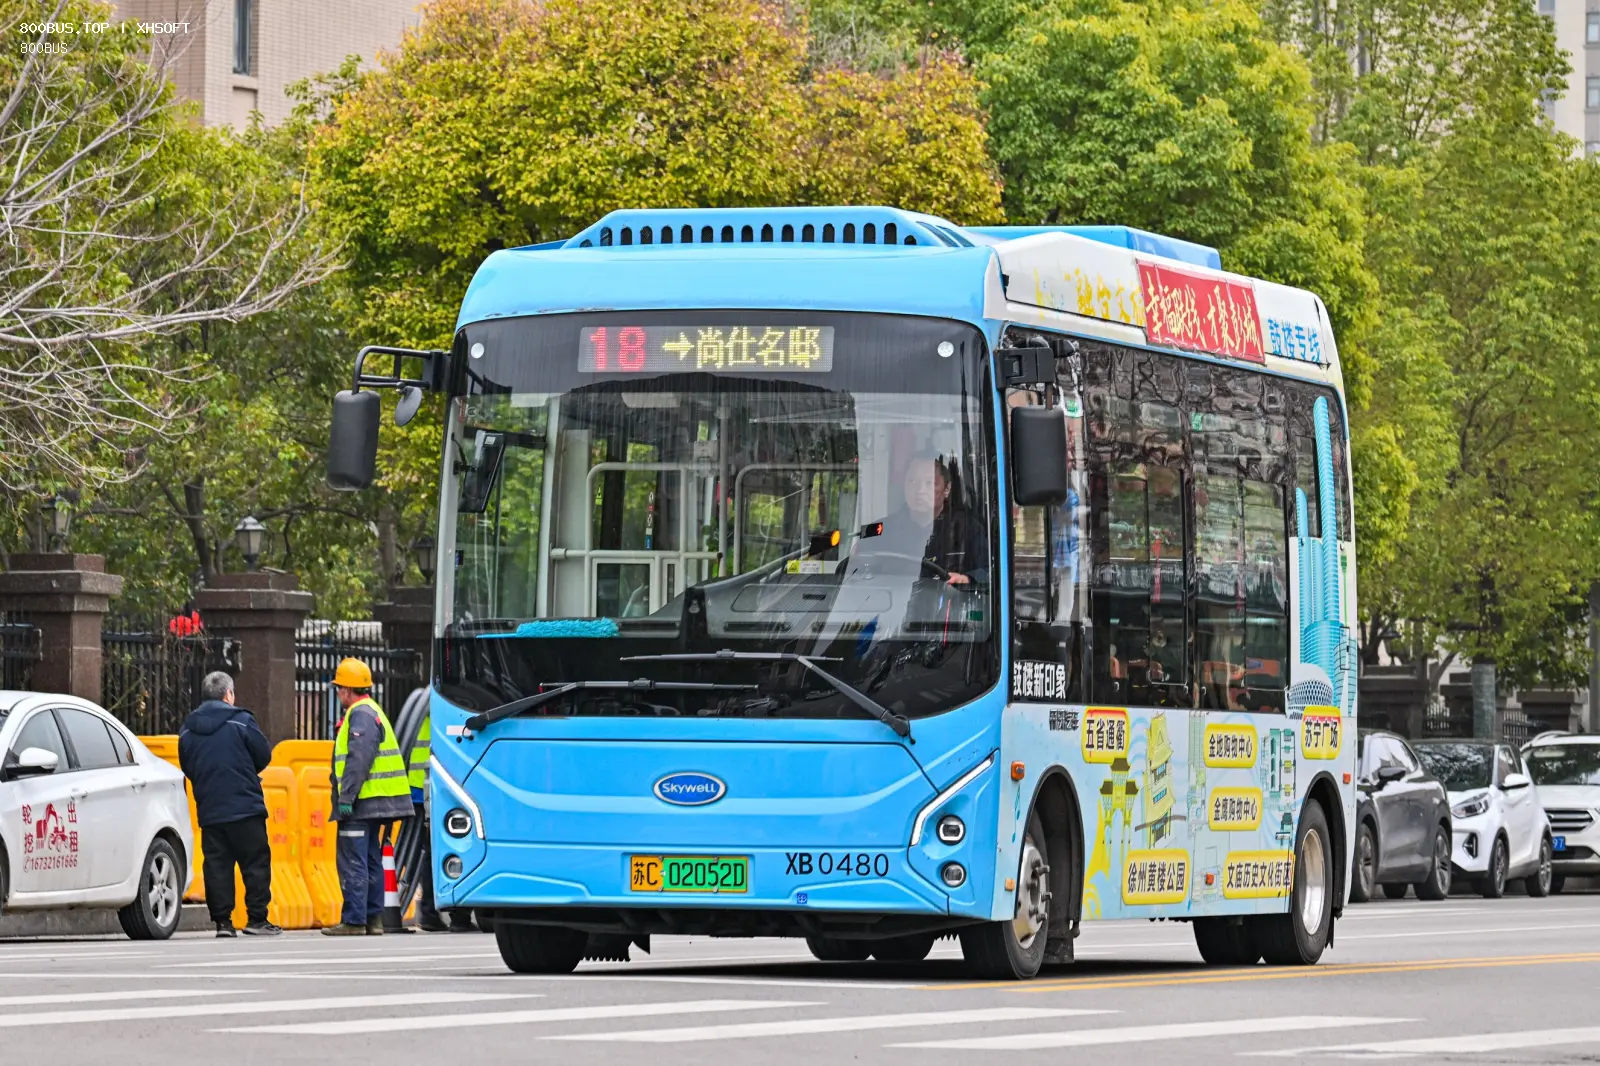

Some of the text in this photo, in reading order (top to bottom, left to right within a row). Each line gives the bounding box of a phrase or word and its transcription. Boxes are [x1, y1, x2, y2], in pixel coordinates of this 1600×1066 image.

[590, 327, 646, 370] 18
[696, 326, 821, 369] 尚仕名邸
[1086, 719, 1125, 750] 五省通衢
[1304, 719, 1338, 748] 苏宁广场
[1128, 862, 1186, 893] 徐州黄楼公园
